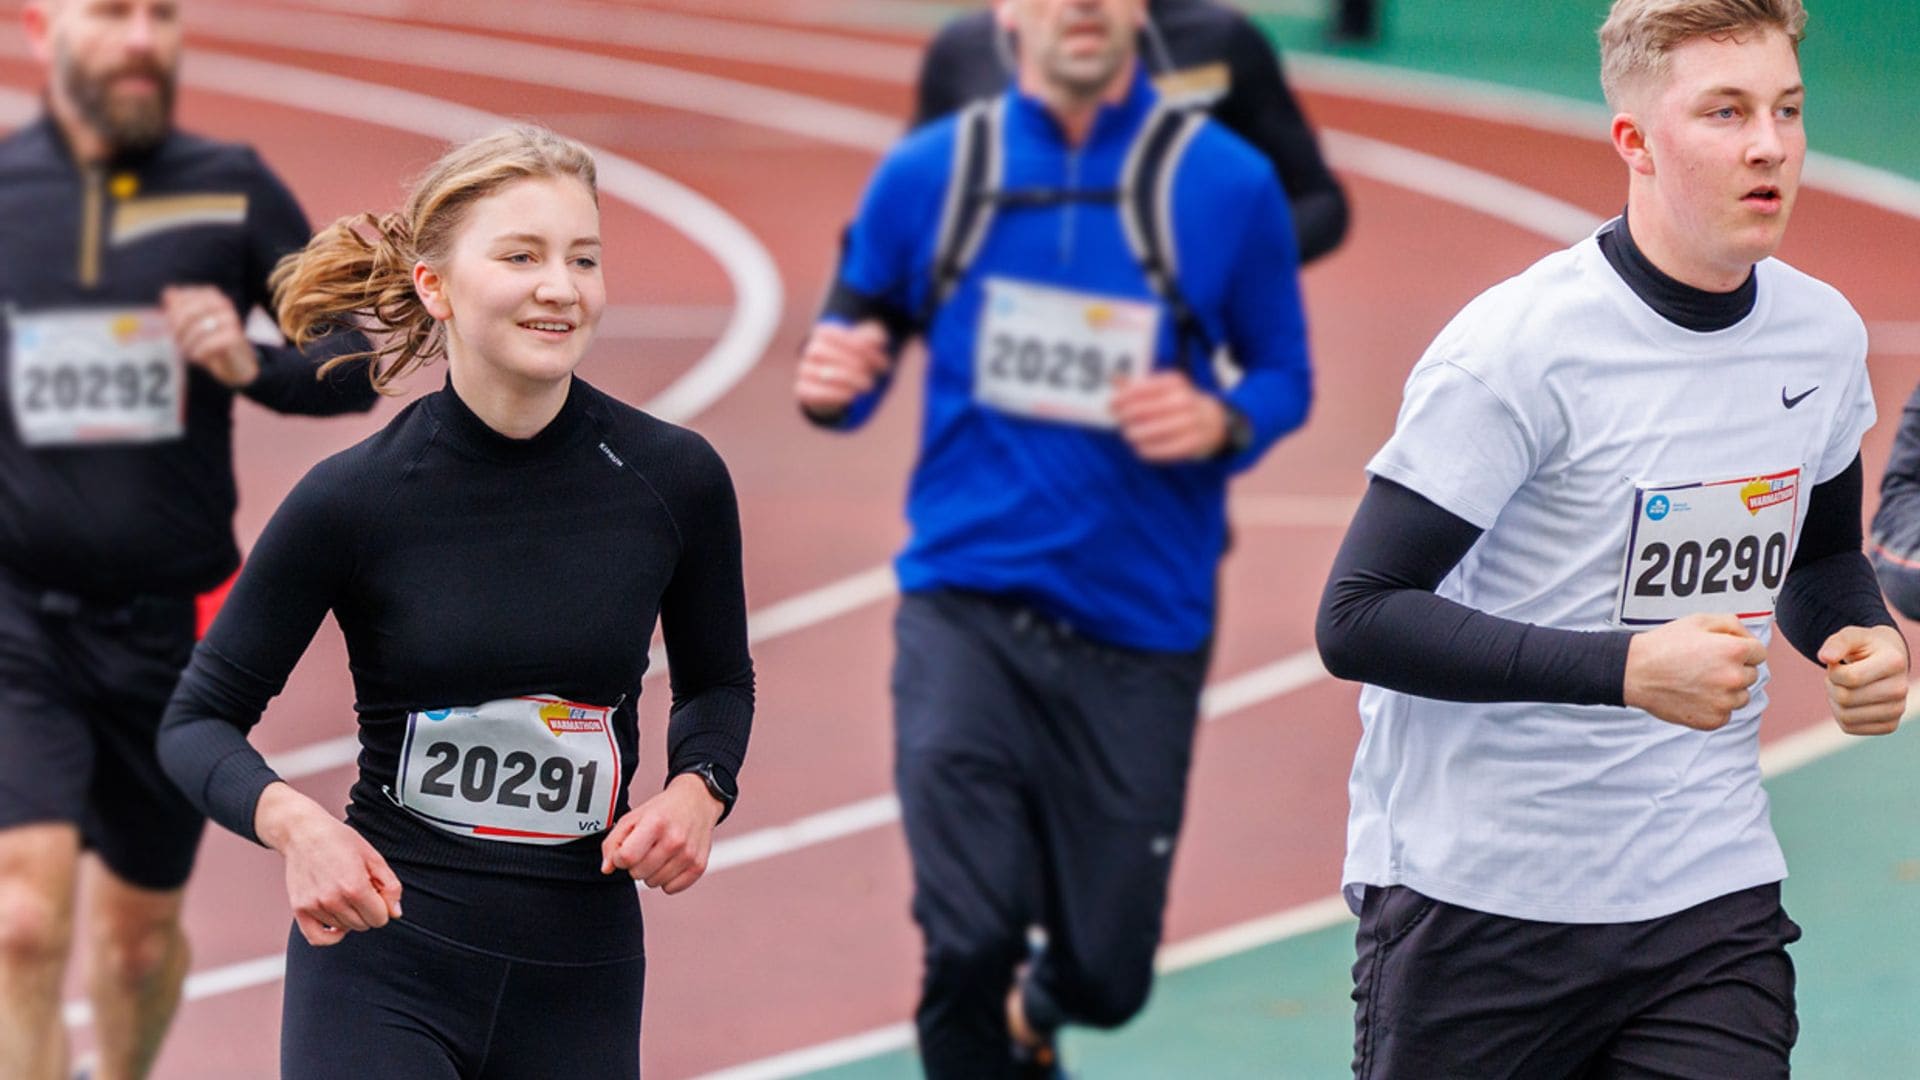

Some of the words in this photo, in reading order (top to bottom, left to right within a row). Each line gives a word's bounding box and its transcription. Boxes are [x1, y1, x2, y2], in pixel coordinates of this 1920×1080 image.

[25, 362, 170, 412] 20292
[1634, 532, 1786, 597] 20290
[420, 742, 598, 814] 20291
